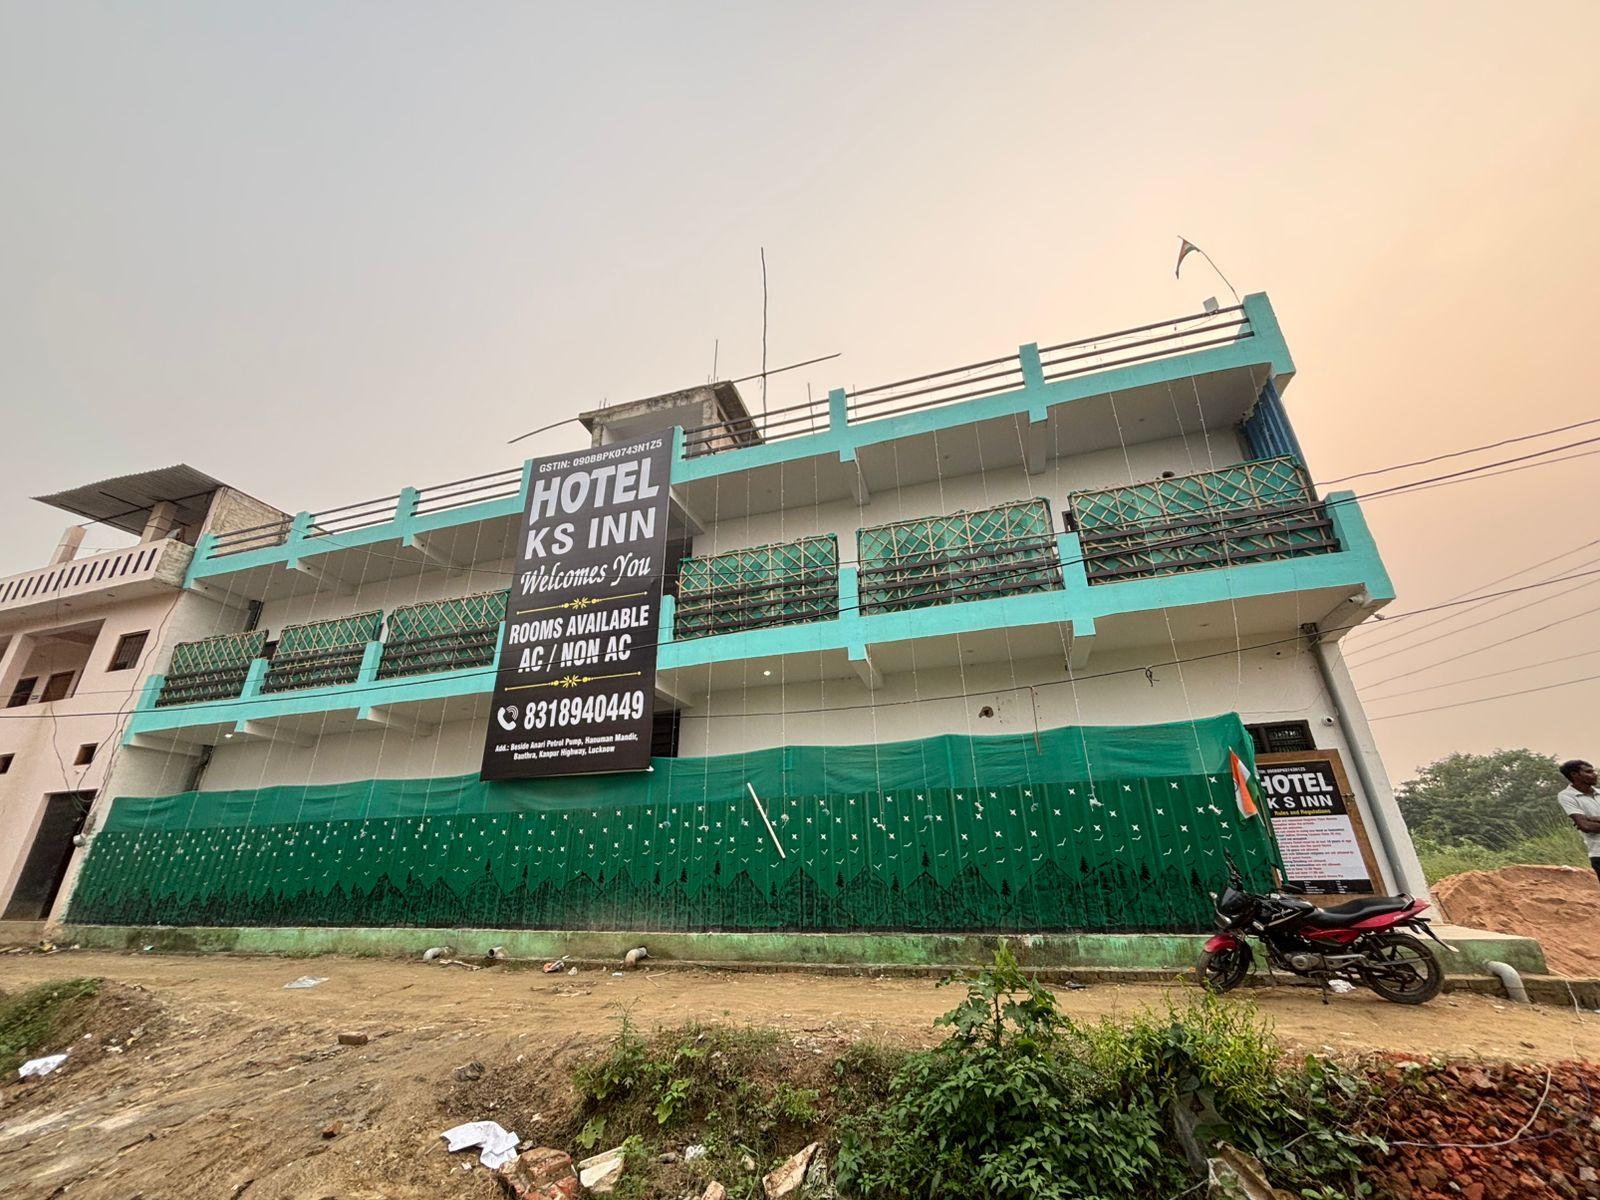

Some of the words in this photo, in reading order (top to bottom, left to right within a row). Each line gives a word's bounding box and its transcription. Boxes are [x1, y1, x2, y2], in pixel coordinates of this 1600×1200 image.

[539, 459, 570, 473] GSTIN:
[528, 457, 660, 526] HOTEL
[524, 522, 575, 560] KS
[588, 506, 656, 549] INN
[520, 562, 608, 596] Welcomes
[610, 552, 651, 587] You
[508, 617, 564, 645] ROOMS
[566, 604, 650, 637] AVAILABLE
[518, 645, 544, 674] AC
[546, 643, 558, 672] /
[560, 637, 600, 668] NON
[604, 633, 632, 663] AC
[523, 690, 645, 731] 8318940449
[510, 742, 529, 751] Beside
[546, 738, 564, 748] Petrol
[565, 737, 584, 747] Pump,
[584, 735, 614, 745] Hanuman
[538, 749, 560, 759] Kanpur
[560, 747, 587, 757] Highway,
[588, 745, 616, 754] Lucknow
[1260, 772, 1334, 795] HOTEL
[1300, 794, 1333, 808] INN
